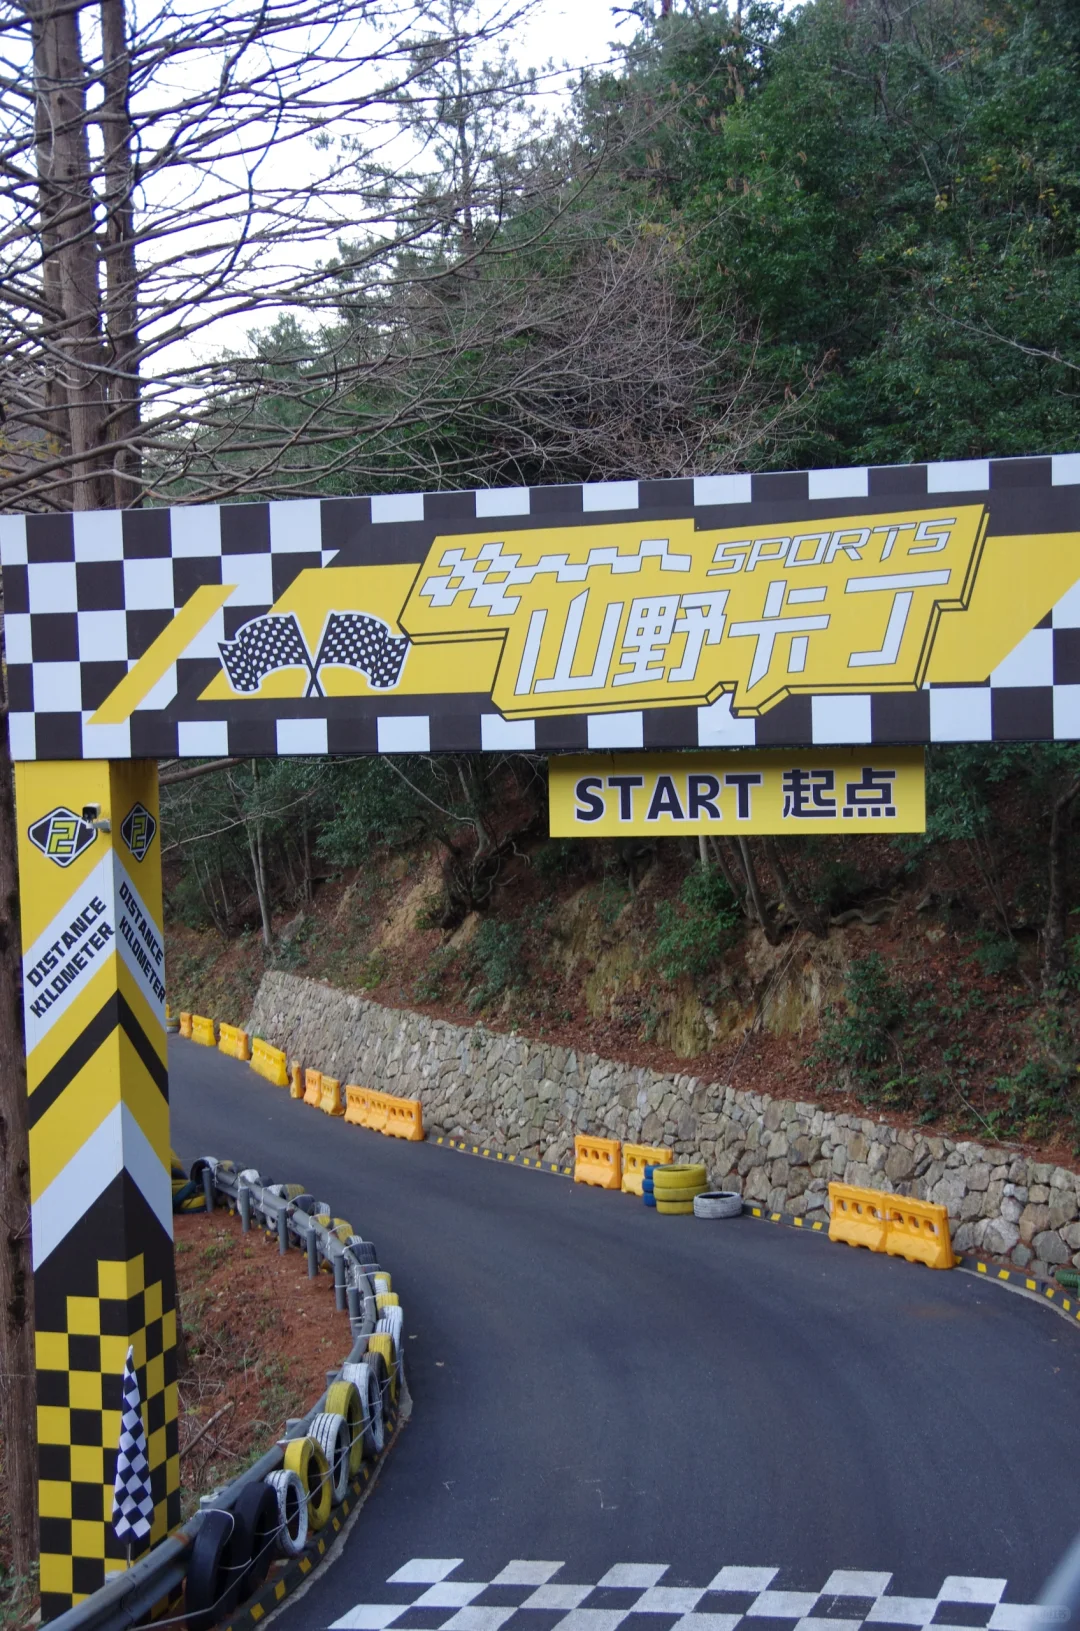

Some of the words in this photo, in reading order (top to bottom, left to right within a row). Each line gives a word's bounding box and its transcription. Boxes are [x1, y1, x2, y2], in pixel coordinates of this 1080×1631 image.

[706, 518, 957, 576] SPORTS
[513, 568, 951, 695] 山野卡丁
[574, 773, 763, 823] START
[782, 767, 896, 819] 起点
[26, 896, 107, 988] DISTANCE
[119, 881, 164, 967] DISTANCE
[119, 915, 167, 1004] KILOMETER
[29, 921, 115, 1018] KILOMETER
